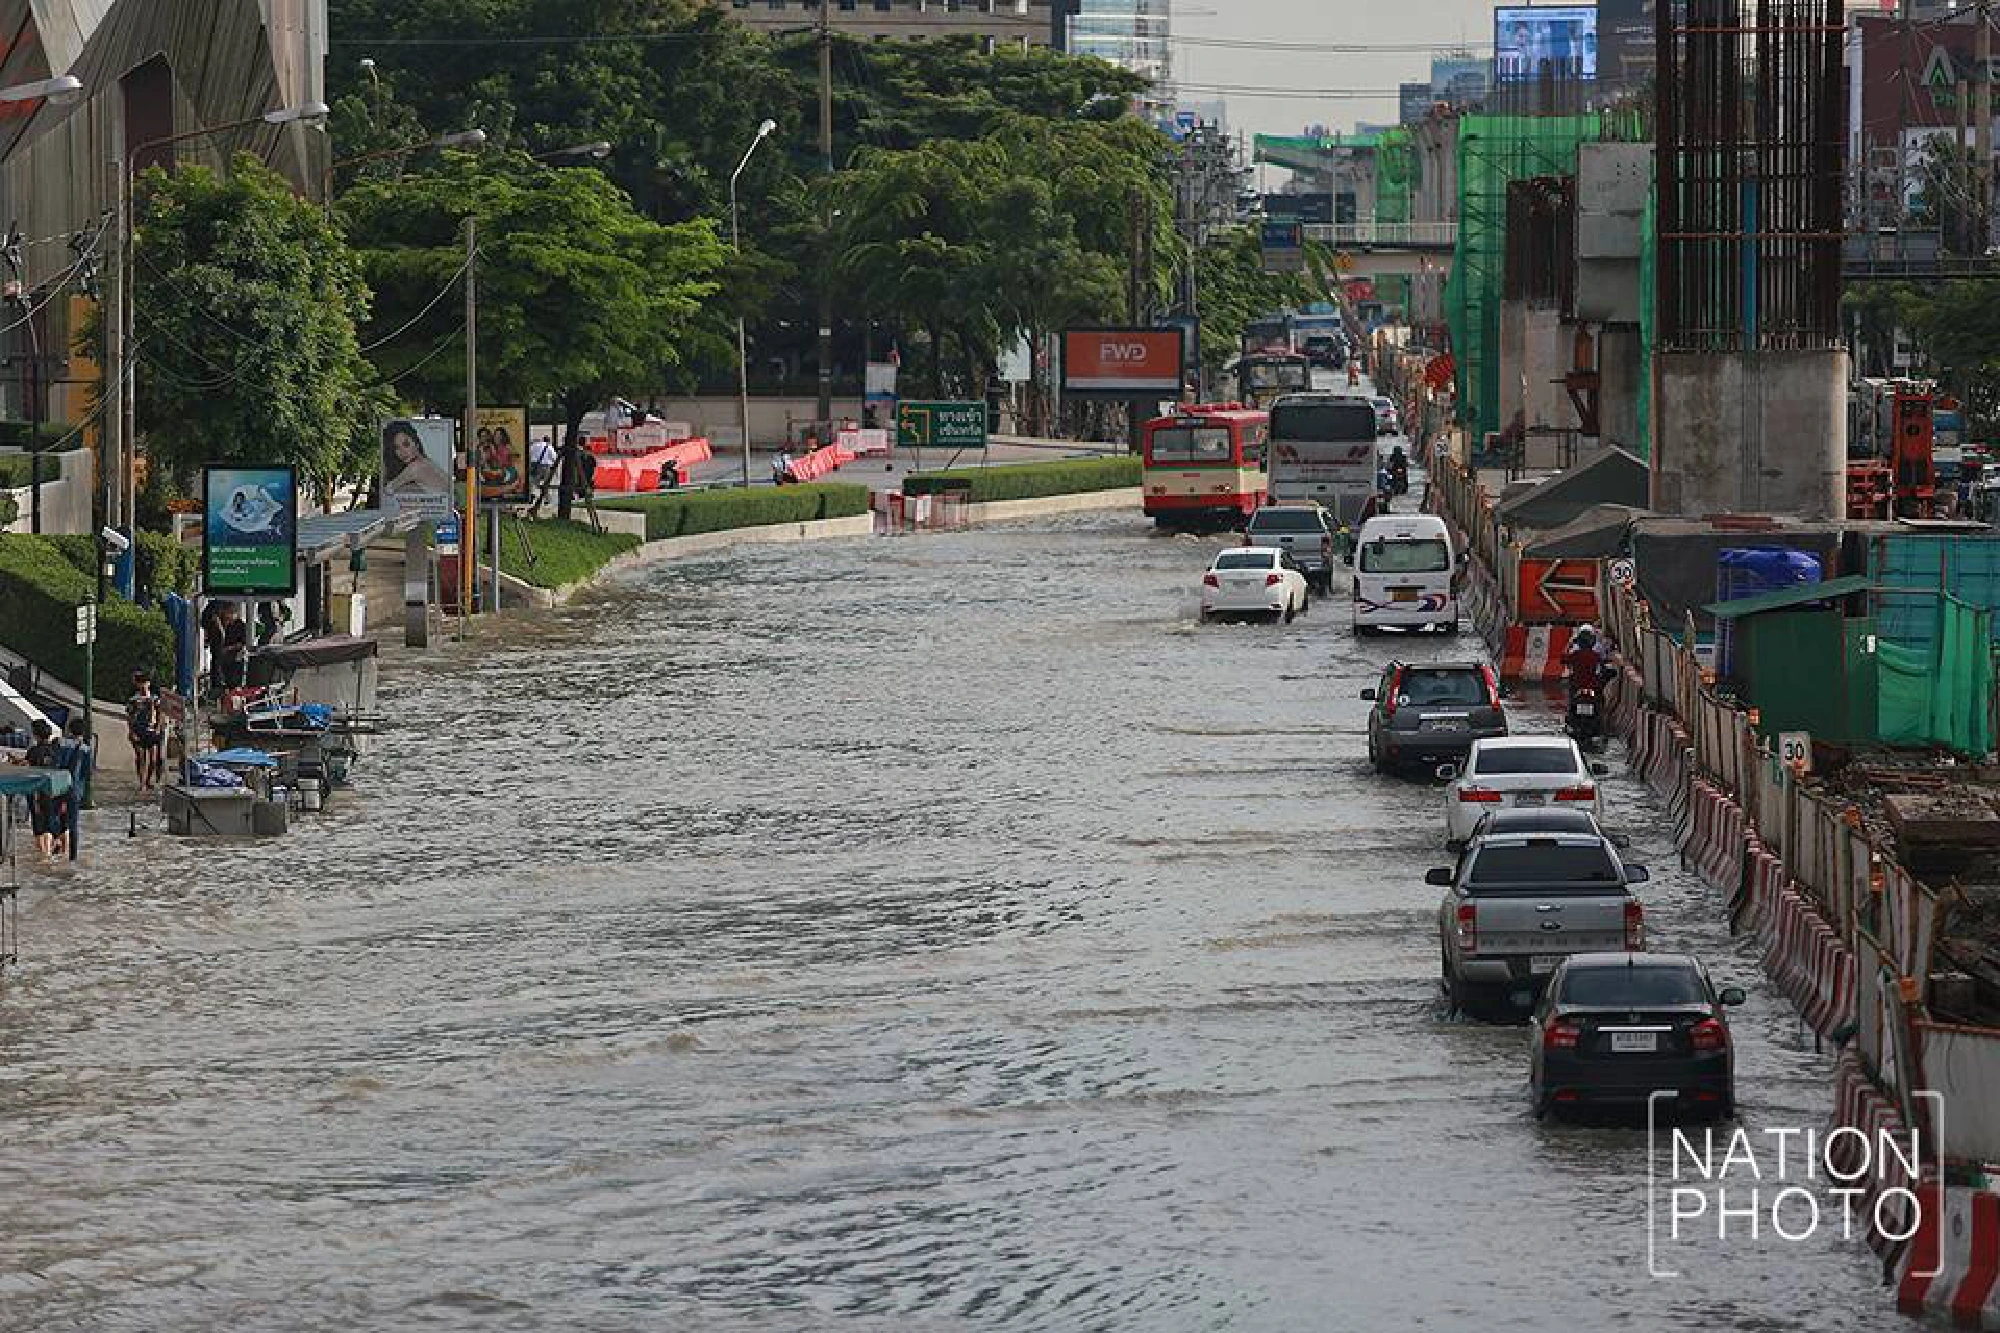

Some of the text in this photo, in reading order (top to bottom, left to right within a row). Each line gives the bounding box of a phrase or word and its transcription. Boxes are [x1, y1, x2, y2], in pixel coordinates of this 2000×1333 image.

[1100, 343, 1148, 361] FWD
[1614, 566, 1632, 580] 30
[1785, 741, 1805, 761] 30
